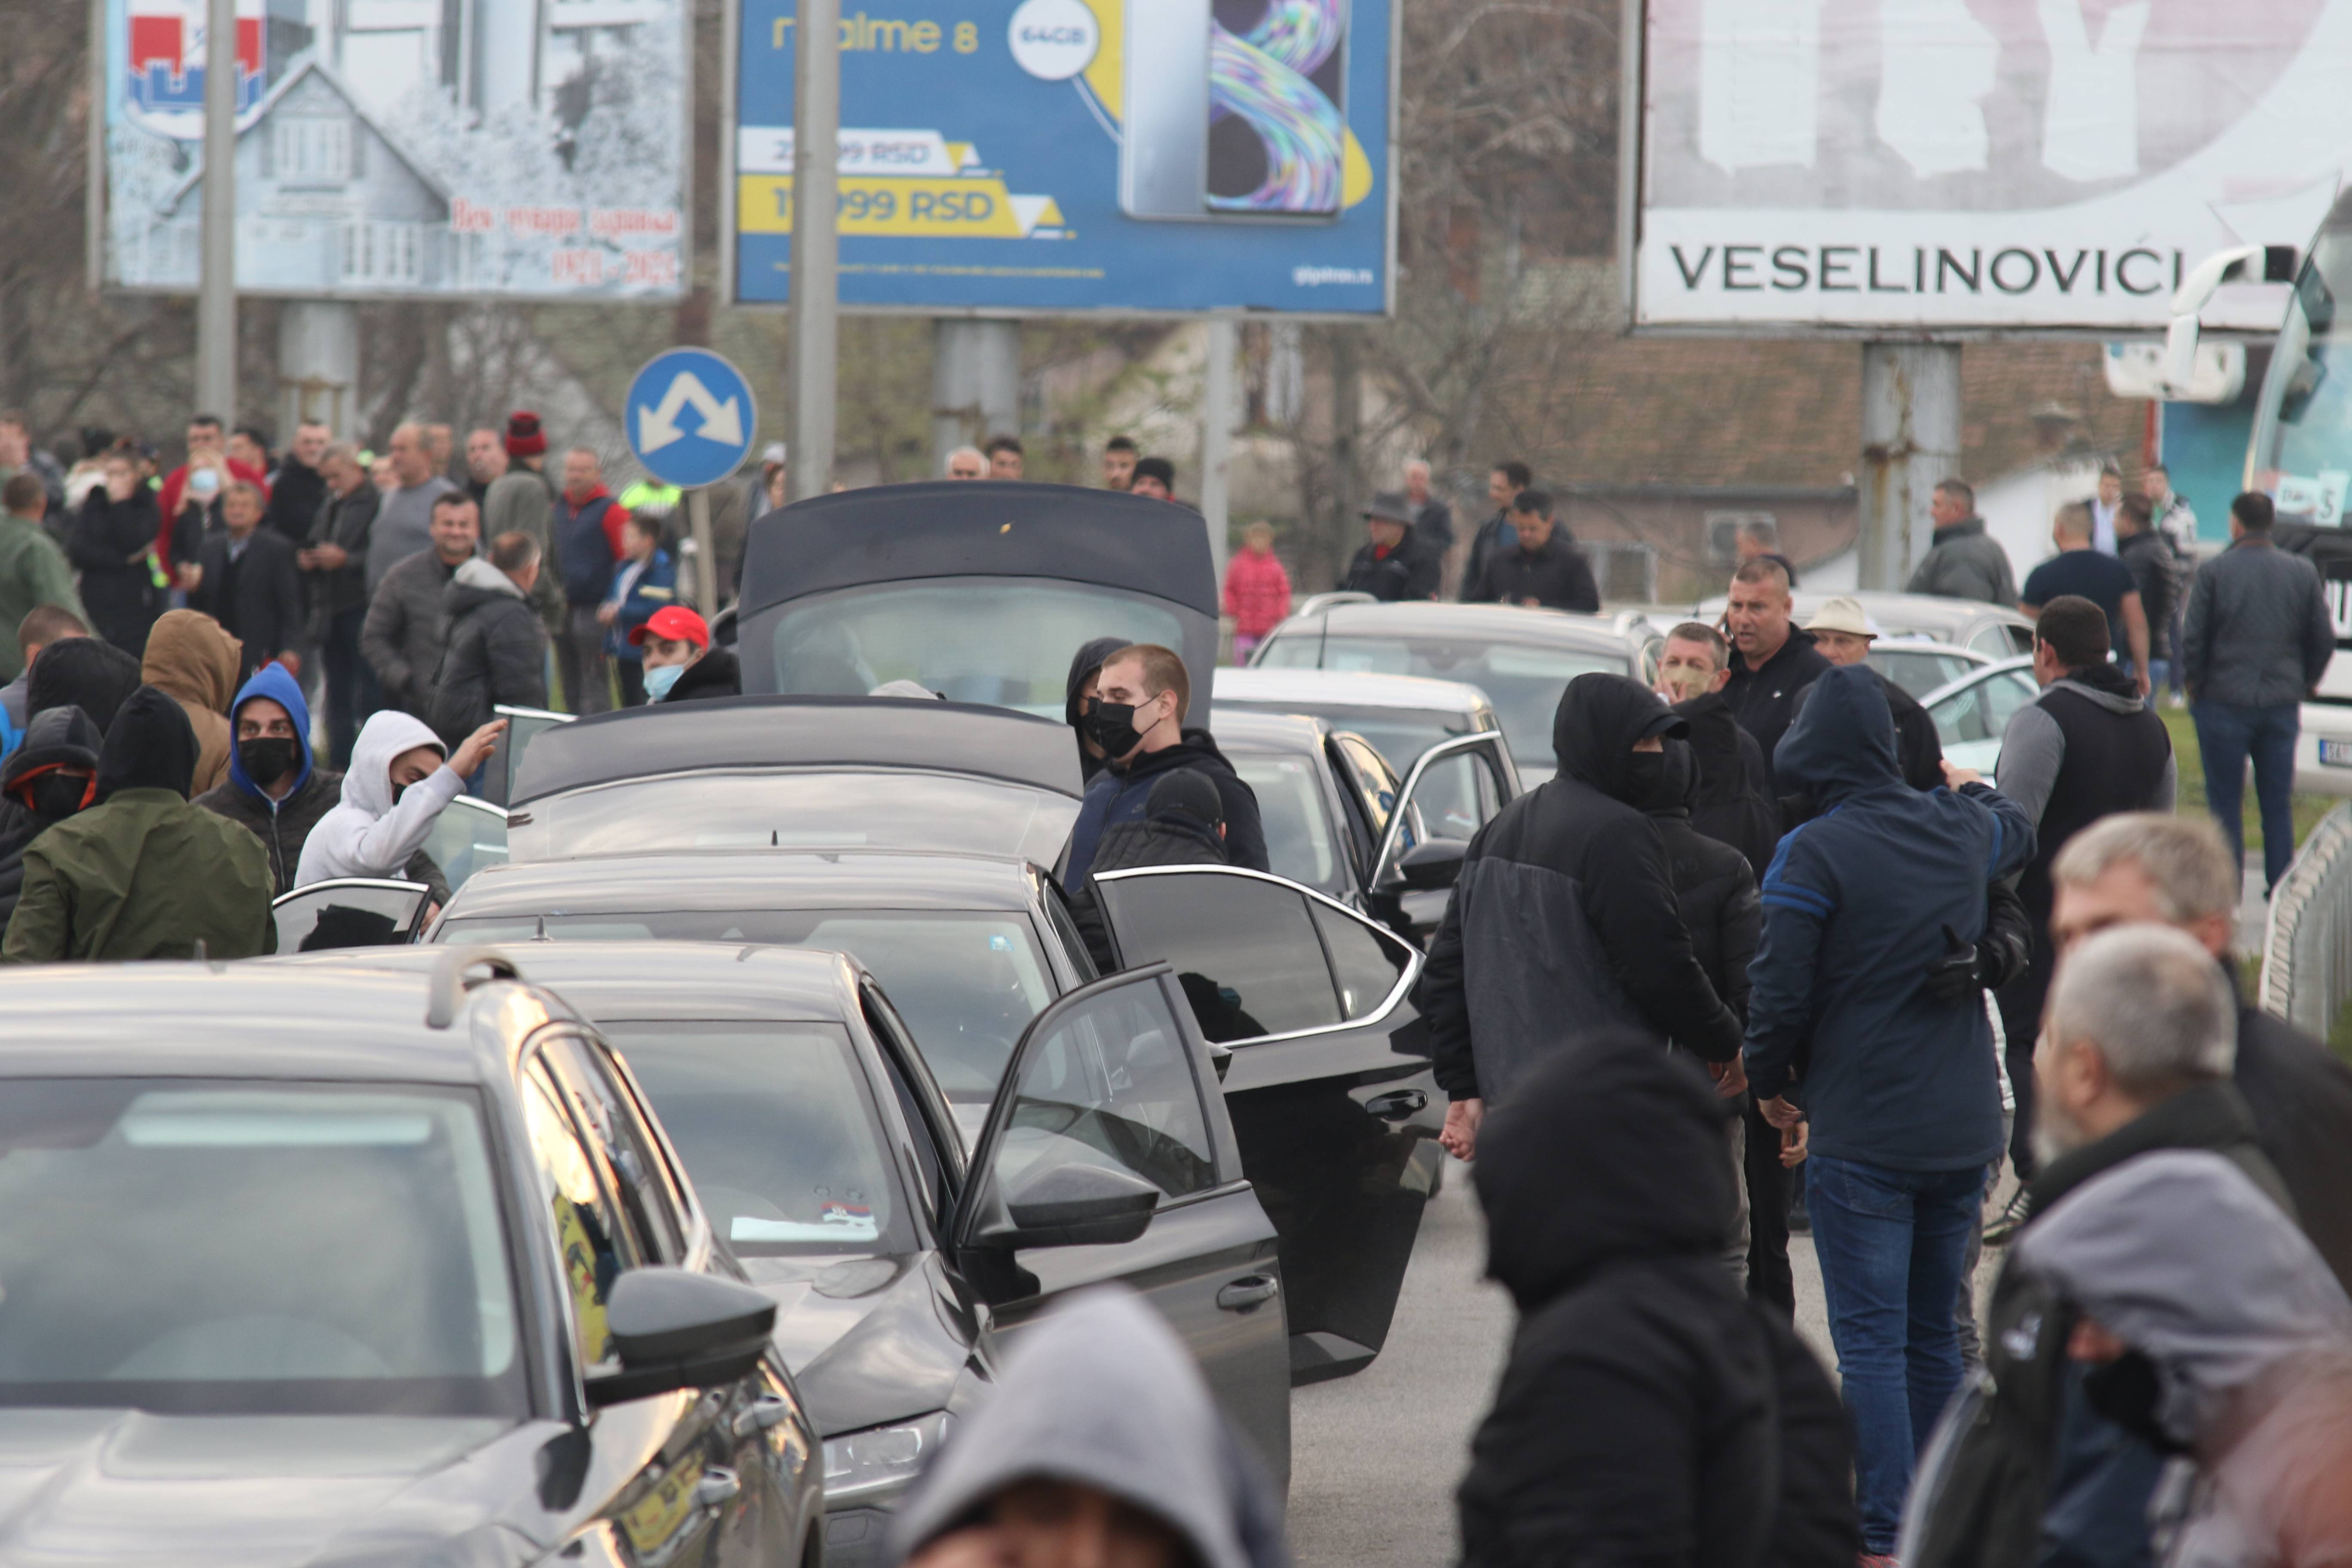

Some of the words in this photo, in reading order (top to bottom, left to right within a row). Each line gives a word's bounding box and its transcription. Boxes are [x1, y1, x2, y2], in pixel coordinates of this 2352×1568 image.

[772, 11, 942, 53] ralme
[953, 21, 978, 54] 8
[1022, 26, 1087, 46] 64GB
[872, 142, 930, 164] RSD
[909, 190, 995, 221] RSD
[1670, 232, 2185, 295] VESELINOVIĆI
